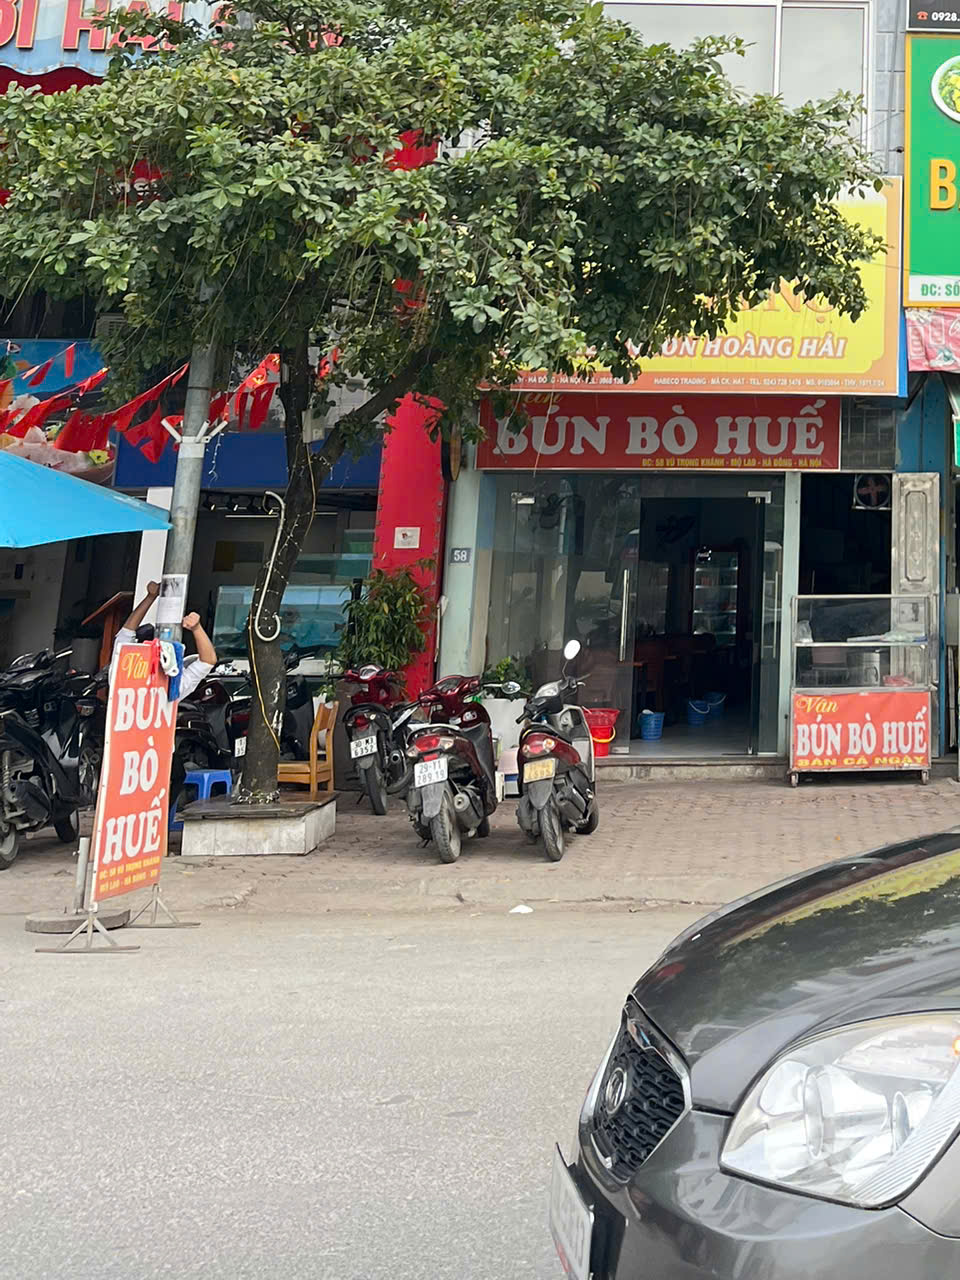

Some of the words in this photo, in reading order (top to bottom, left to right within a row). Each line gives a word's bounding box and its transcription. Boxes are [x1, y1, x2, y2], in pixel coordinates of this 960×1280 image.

[920, 283, 941, 297] ĐC:
[944, 280, 960, 297] SỐ
[703, 332, 793, 358] HOÀNG
[798, 331, 847, 360] HẢI
[492, 404, 612, 455] BÚN
[625, 404, 698, 456] BÒ
[713, 398, 827, 456] HUẾ
[453, 550, 468, 562] 58
[113, 675, 174, 732] BÚN
[796, 697, 839, 713] Vân
[796, 713, 843, 757] BÚN
[847, 712, 877, 756] BÒ
[882, 705, 927, 755] HUẾ
[119, 735, 159, 796] BÒ
[102, 787, 166, 865] HUẾ
